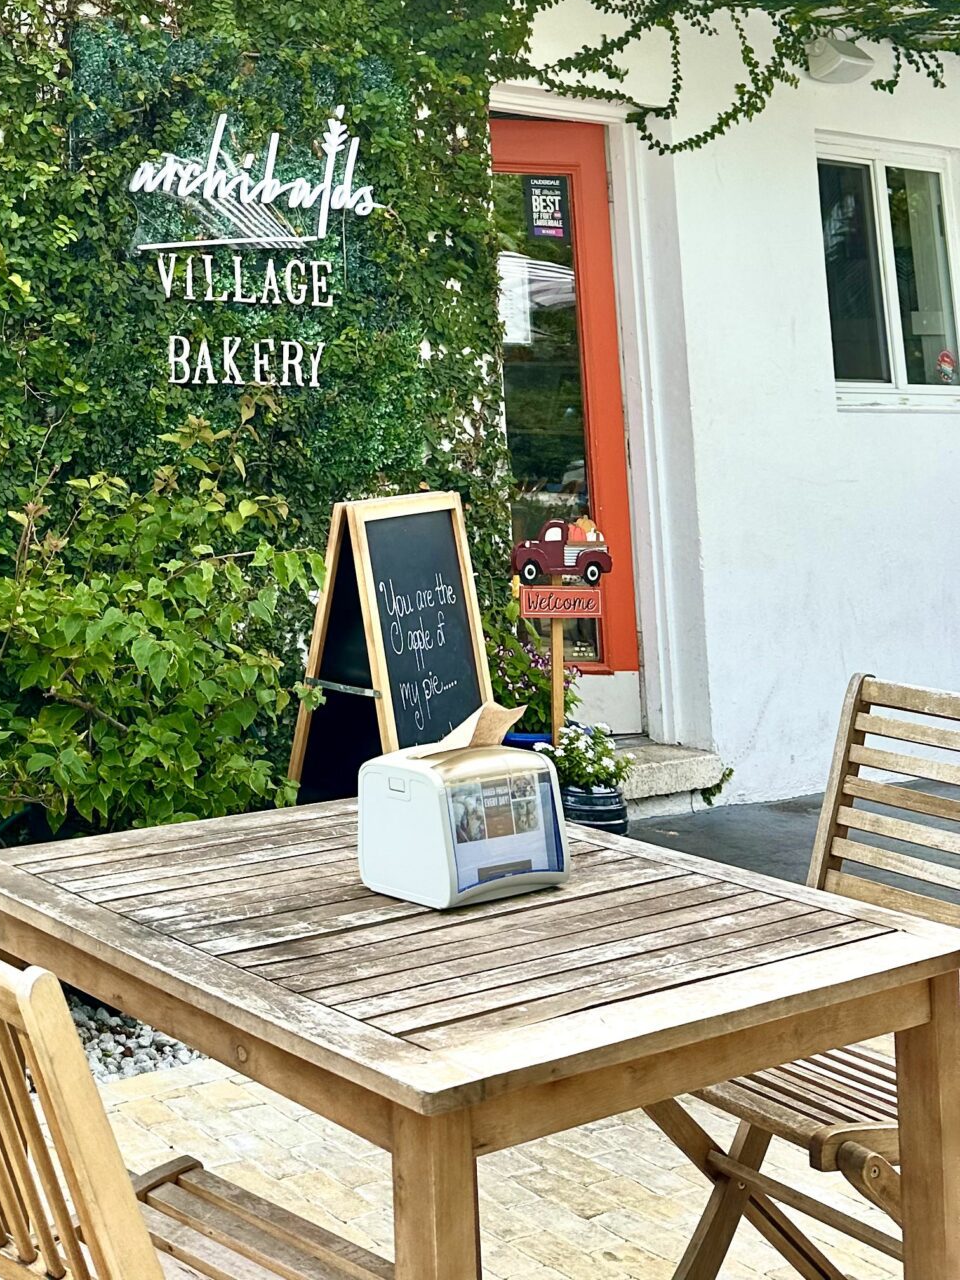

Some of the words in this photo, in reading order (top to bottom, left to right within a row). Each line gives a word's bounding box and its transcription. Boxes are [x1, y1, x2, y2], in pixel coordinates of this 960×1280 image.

[129, 105, 388, 239] archibalds
[532, 196, 561, 213] BEST
[157, 253, 334, 308] VILLAGE
[168, 335, 325, 388] BAKERY
[379, 578, 414, 655] You
[416, 589, 435, 611] are
[434, 573, 457, 605] the
[528, 592, 597, 612] Welcome
[407, 616, 434, 672] apple
[437, 611, 446, 647] of
